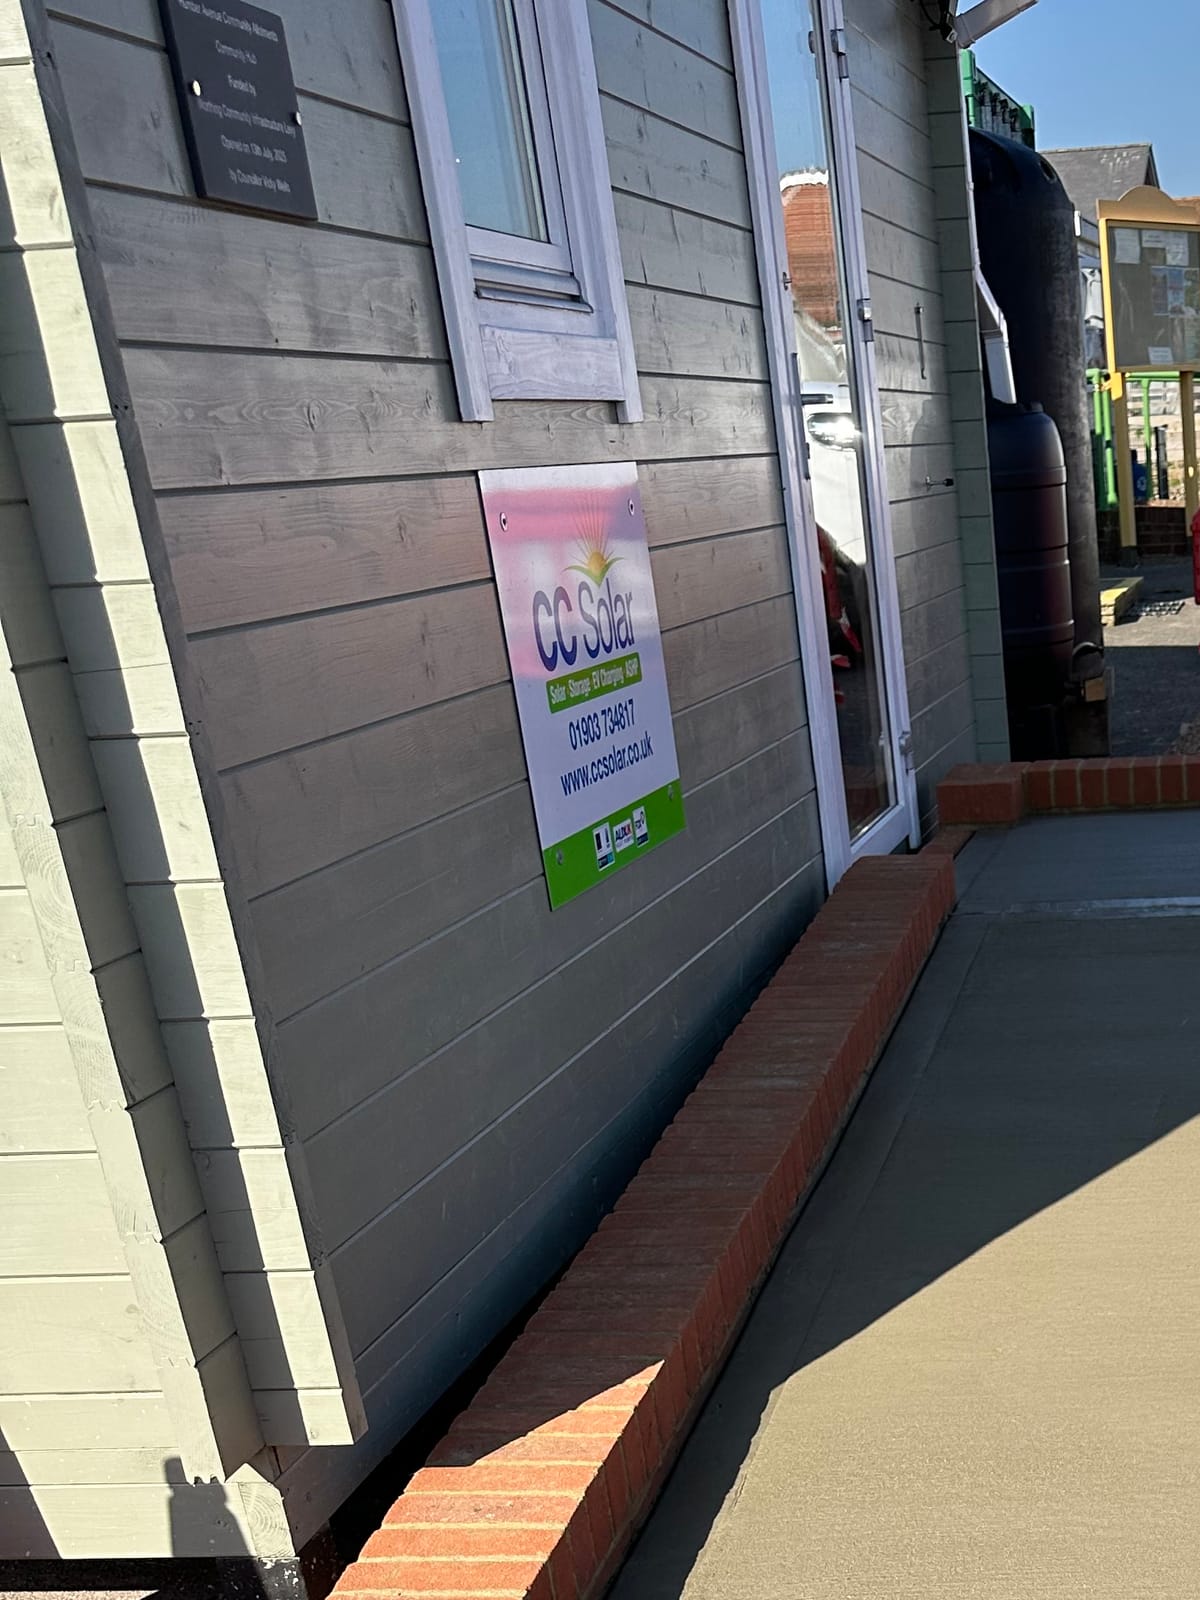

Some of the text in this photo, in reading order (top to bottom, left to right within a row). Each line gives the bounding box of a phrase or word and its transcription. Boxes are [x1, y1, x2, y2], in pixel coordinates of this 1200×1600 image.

[532, 577, 635, 672] CC Solar
[549, 684, 567, 705] Solar
[568, 677, 591, 697] Storage
[591, 670, 601, 690] EV
[600, 665, 624, 687] Charging
[568, 698, 635, 751] 01903 734817
[560, 729, 654, 796] www.ccsolar.co.uk
